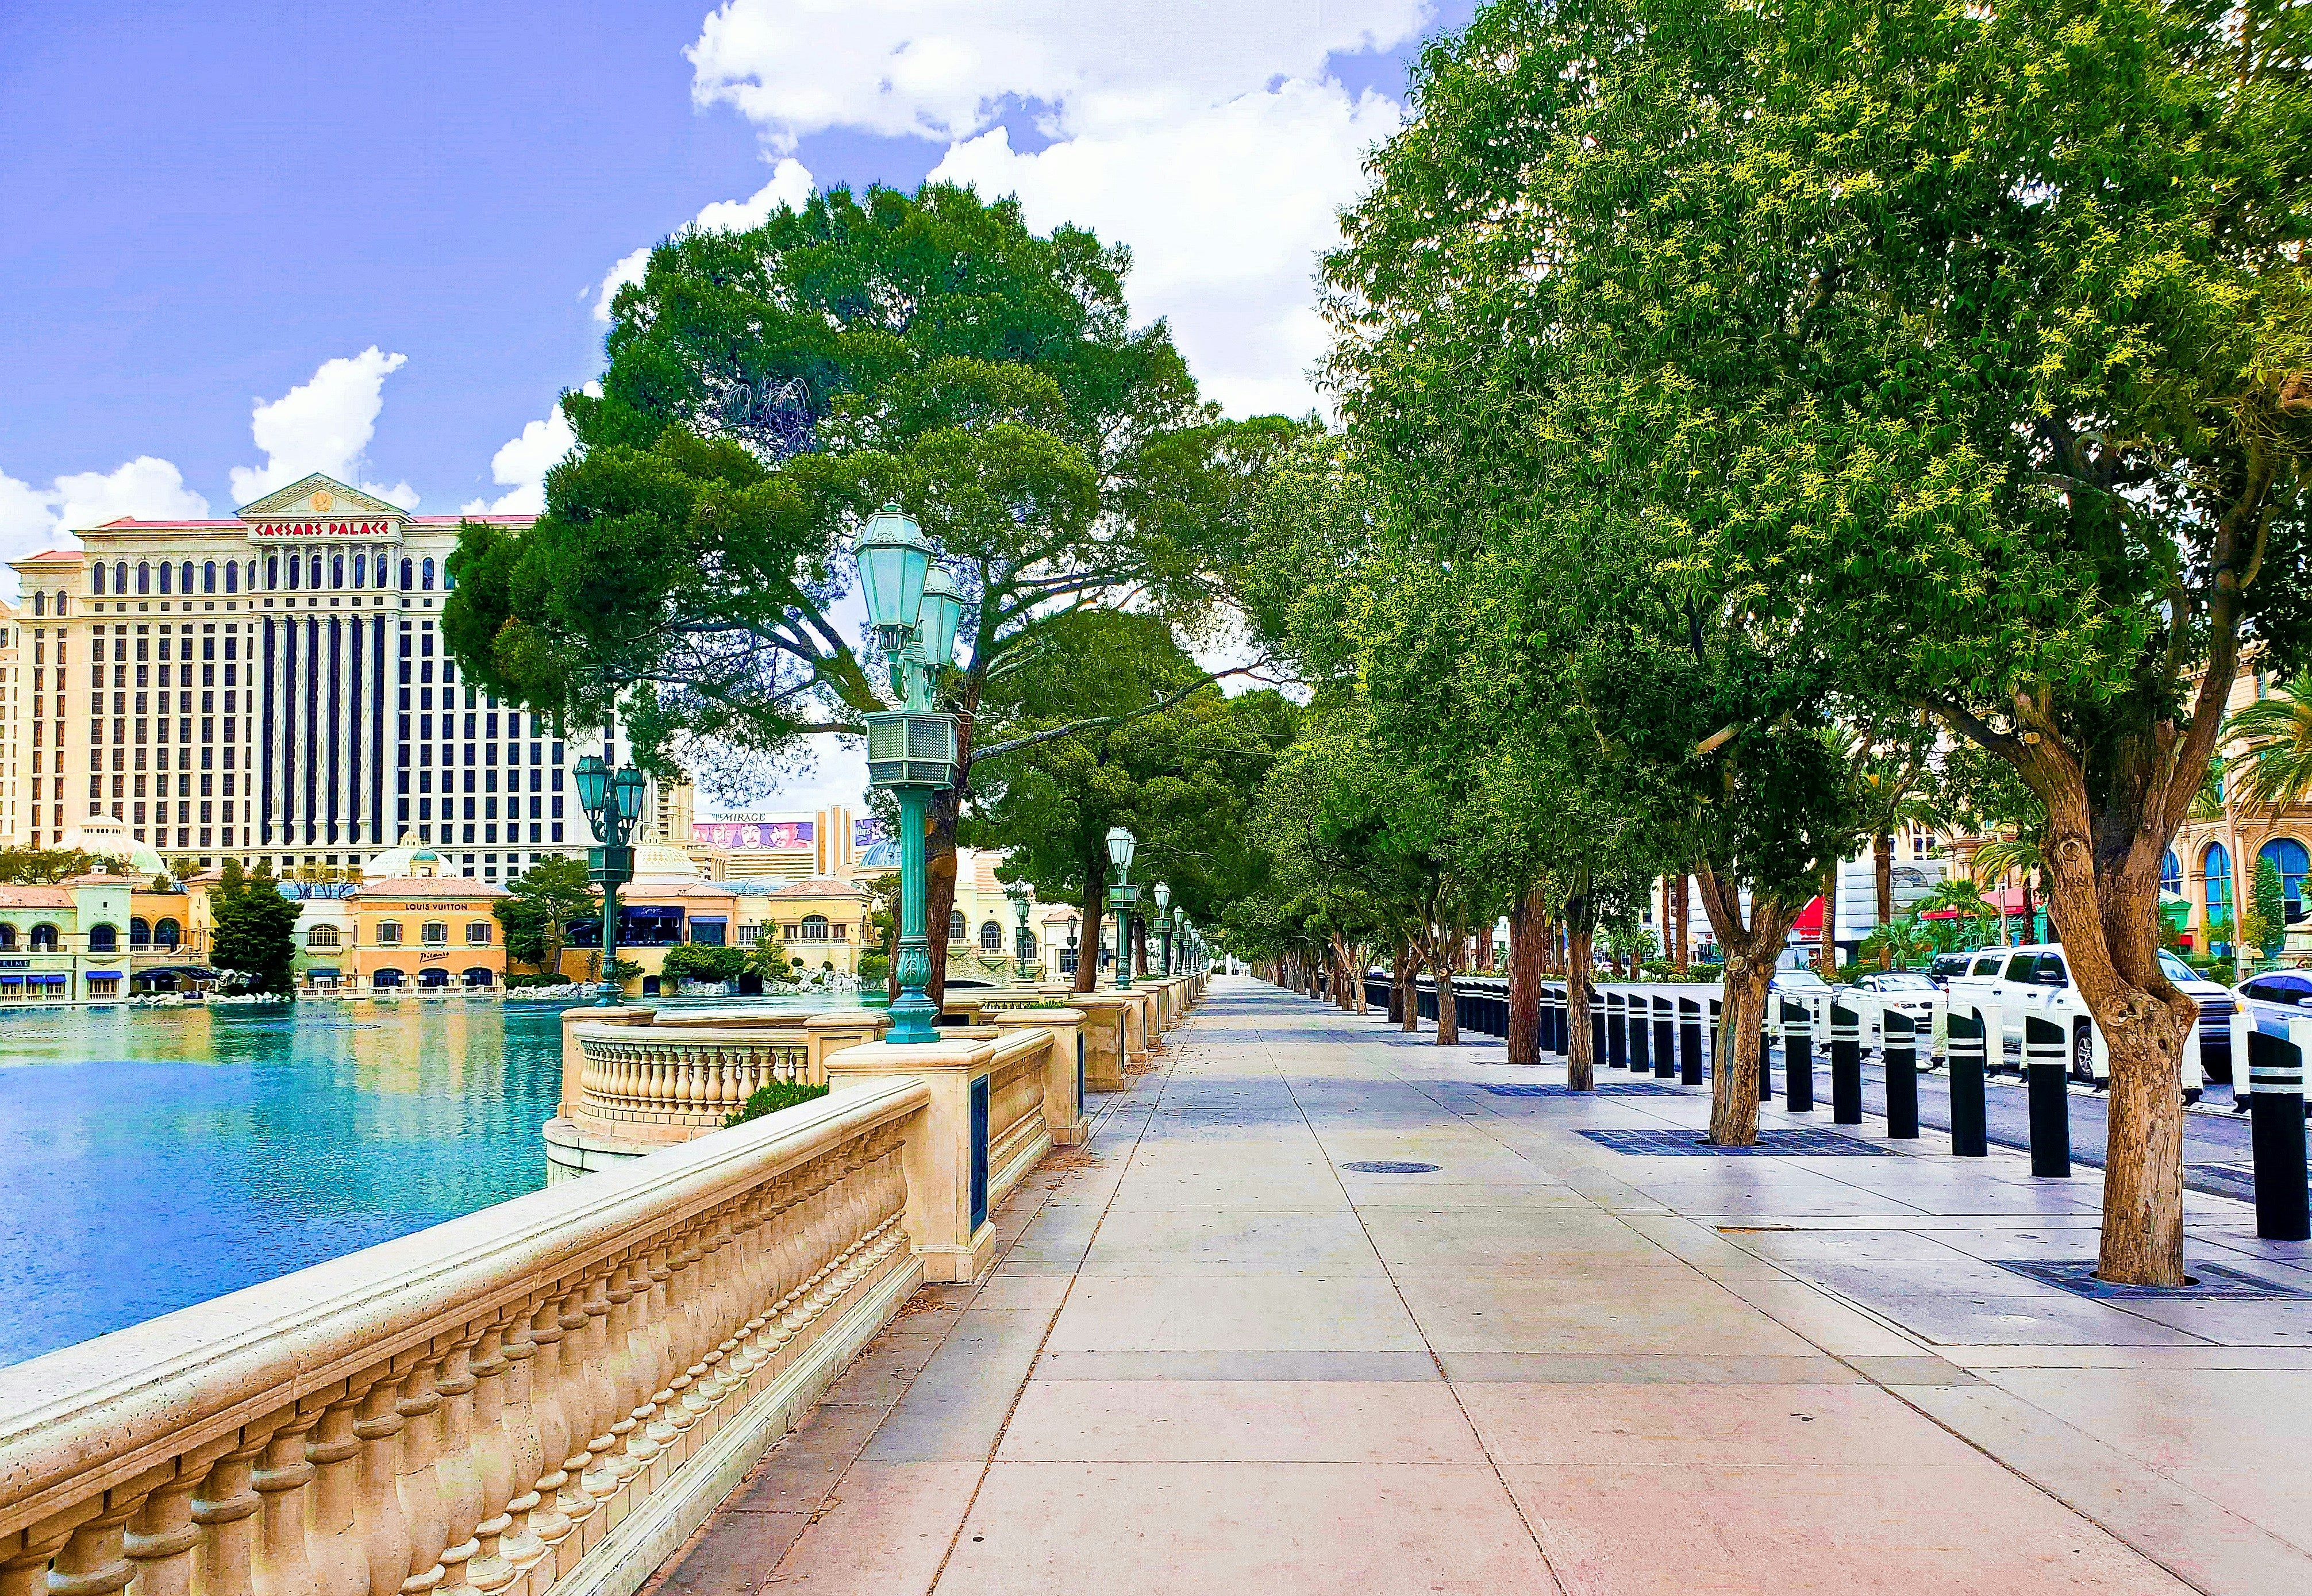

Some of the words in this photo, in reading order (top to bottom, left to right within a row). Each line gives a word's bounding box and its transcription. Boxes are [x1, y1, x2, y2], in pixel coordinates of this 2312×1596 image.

[255, 522, 322, 536] CAESARS
[329, 522, 388, 535] PALACE
[724, 813, 765, 822] MIRAGE
